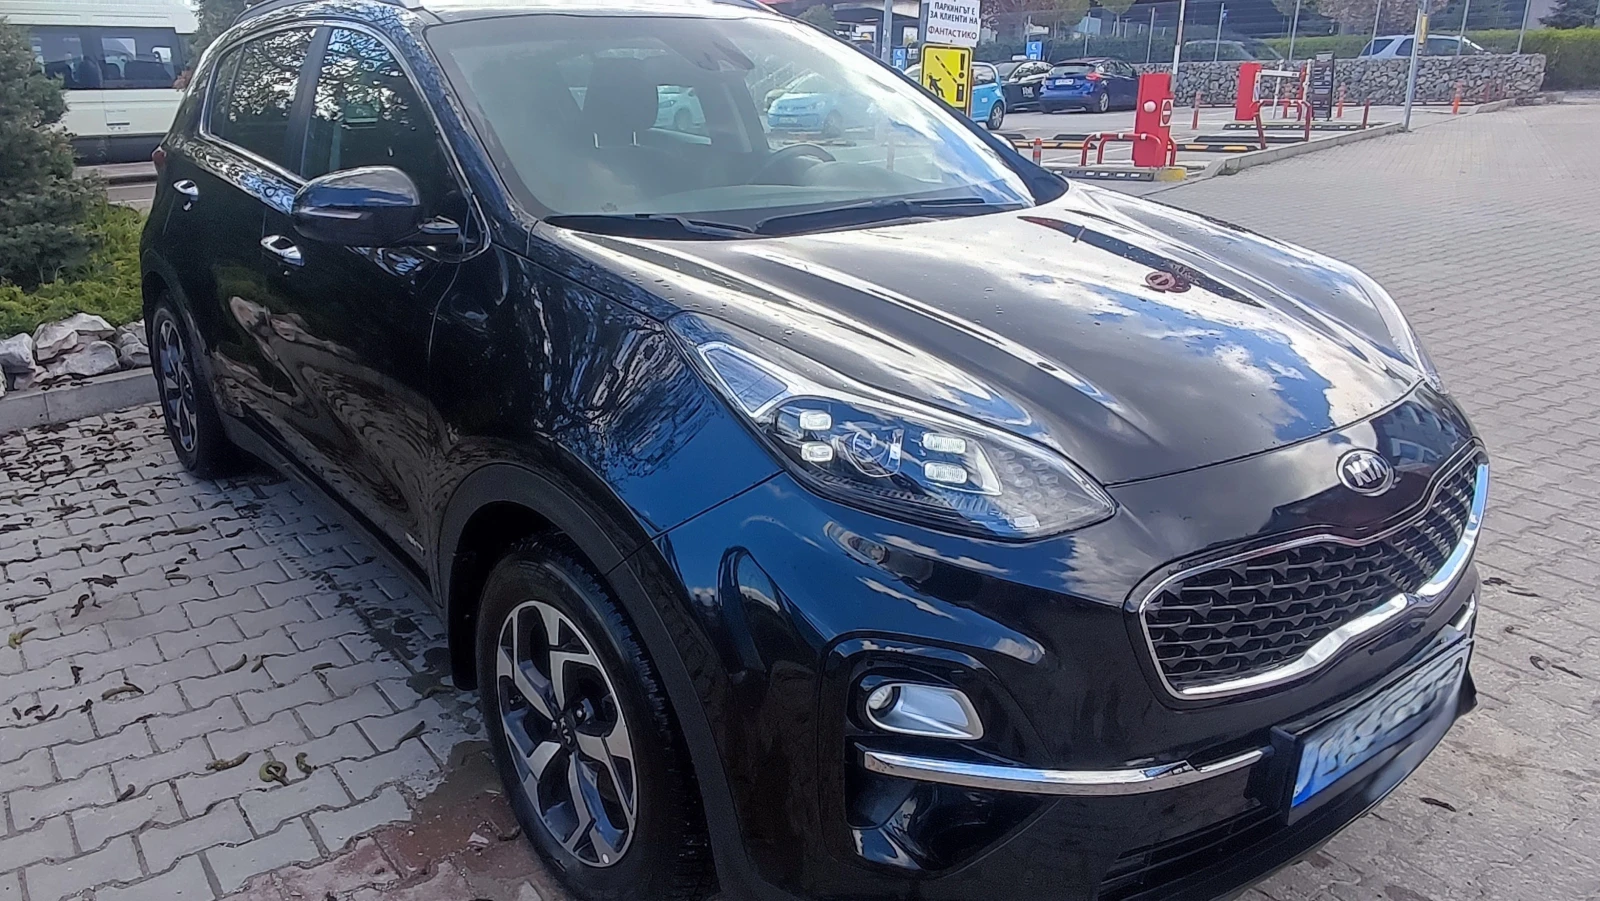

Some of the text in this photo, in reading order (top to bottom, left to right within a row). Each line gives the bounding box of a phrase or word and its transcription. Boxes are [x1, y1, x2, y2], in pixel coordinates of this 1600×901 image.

[934, 2, 976, 15] ПАРКИНГЪТ Е
[930, 10, 978, 25] ЗА КЛИЕНТИ НА
[928, 26, 977, 39] ФАНТАСТИКО
[1345, 457, 1387, 486] KIA
